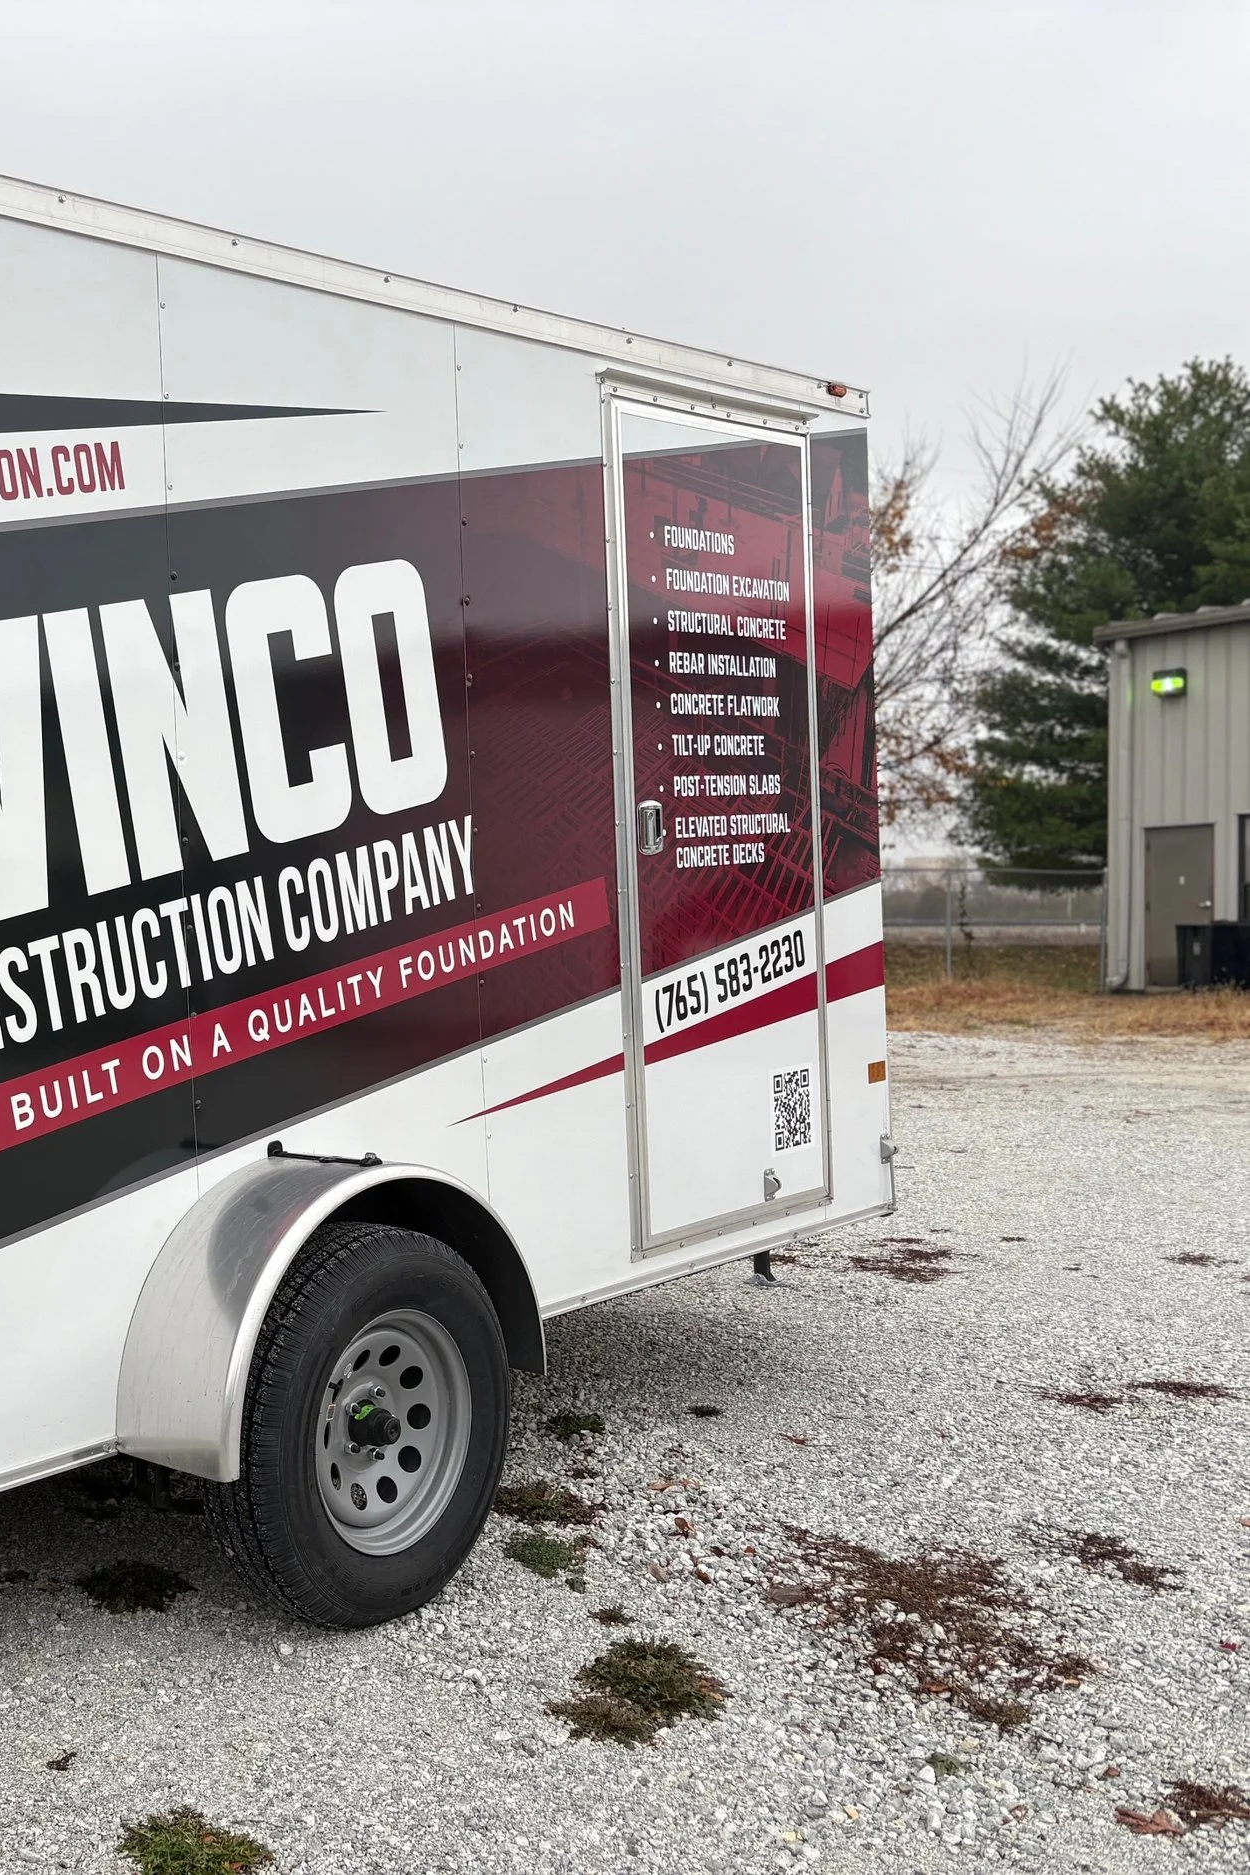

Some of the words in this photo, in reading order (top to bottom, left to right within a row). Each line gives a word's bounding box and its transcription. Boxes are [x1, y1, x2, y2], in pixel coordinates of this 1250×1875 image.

[664, 526, 735, 556] FOUNDATIONS
[666, 568, 730, 596] FOUNDATION
[733, 576, 790, 602] EXCAVATION
[668, 610, 734, 637] STRUCTURAL
[737, 617, 787, 640] CONCRETE
[669, 652, 705, 675] REBAR
[708, 654, 776, 679] INSTALLATION
[670, 693, 725, 717] CONCRETE
[728, 695, 780, 718] FLATWORK
[672, 734, 711, 757] TILT-UP
[714, 735, 765, 757] CONCRETE
[673, 775, 747, 798] POST-TENSION
[749, 774, 781, 796] SLABS
[675, 816, 728, 839] ELEVATED
[730, 813, 791, 836] STRUCTURAL
[676, 845, 731, 869] CONCRETE
[733, 843, 765, 865] DECKS
[278, 815, 474, 953] COMPANY
[654, 970, 710, 1034] (765)
[714, 930, 806, 1004] 583-2230
[10, 1058, 121, 1131] BUILT
[142, 1034, 193, 1081] ON
[212, 1023, 232, 1058] A
[247, 966, 384, 1042] QUALITY
[399, 901, 576, 989] FOUNDATION
